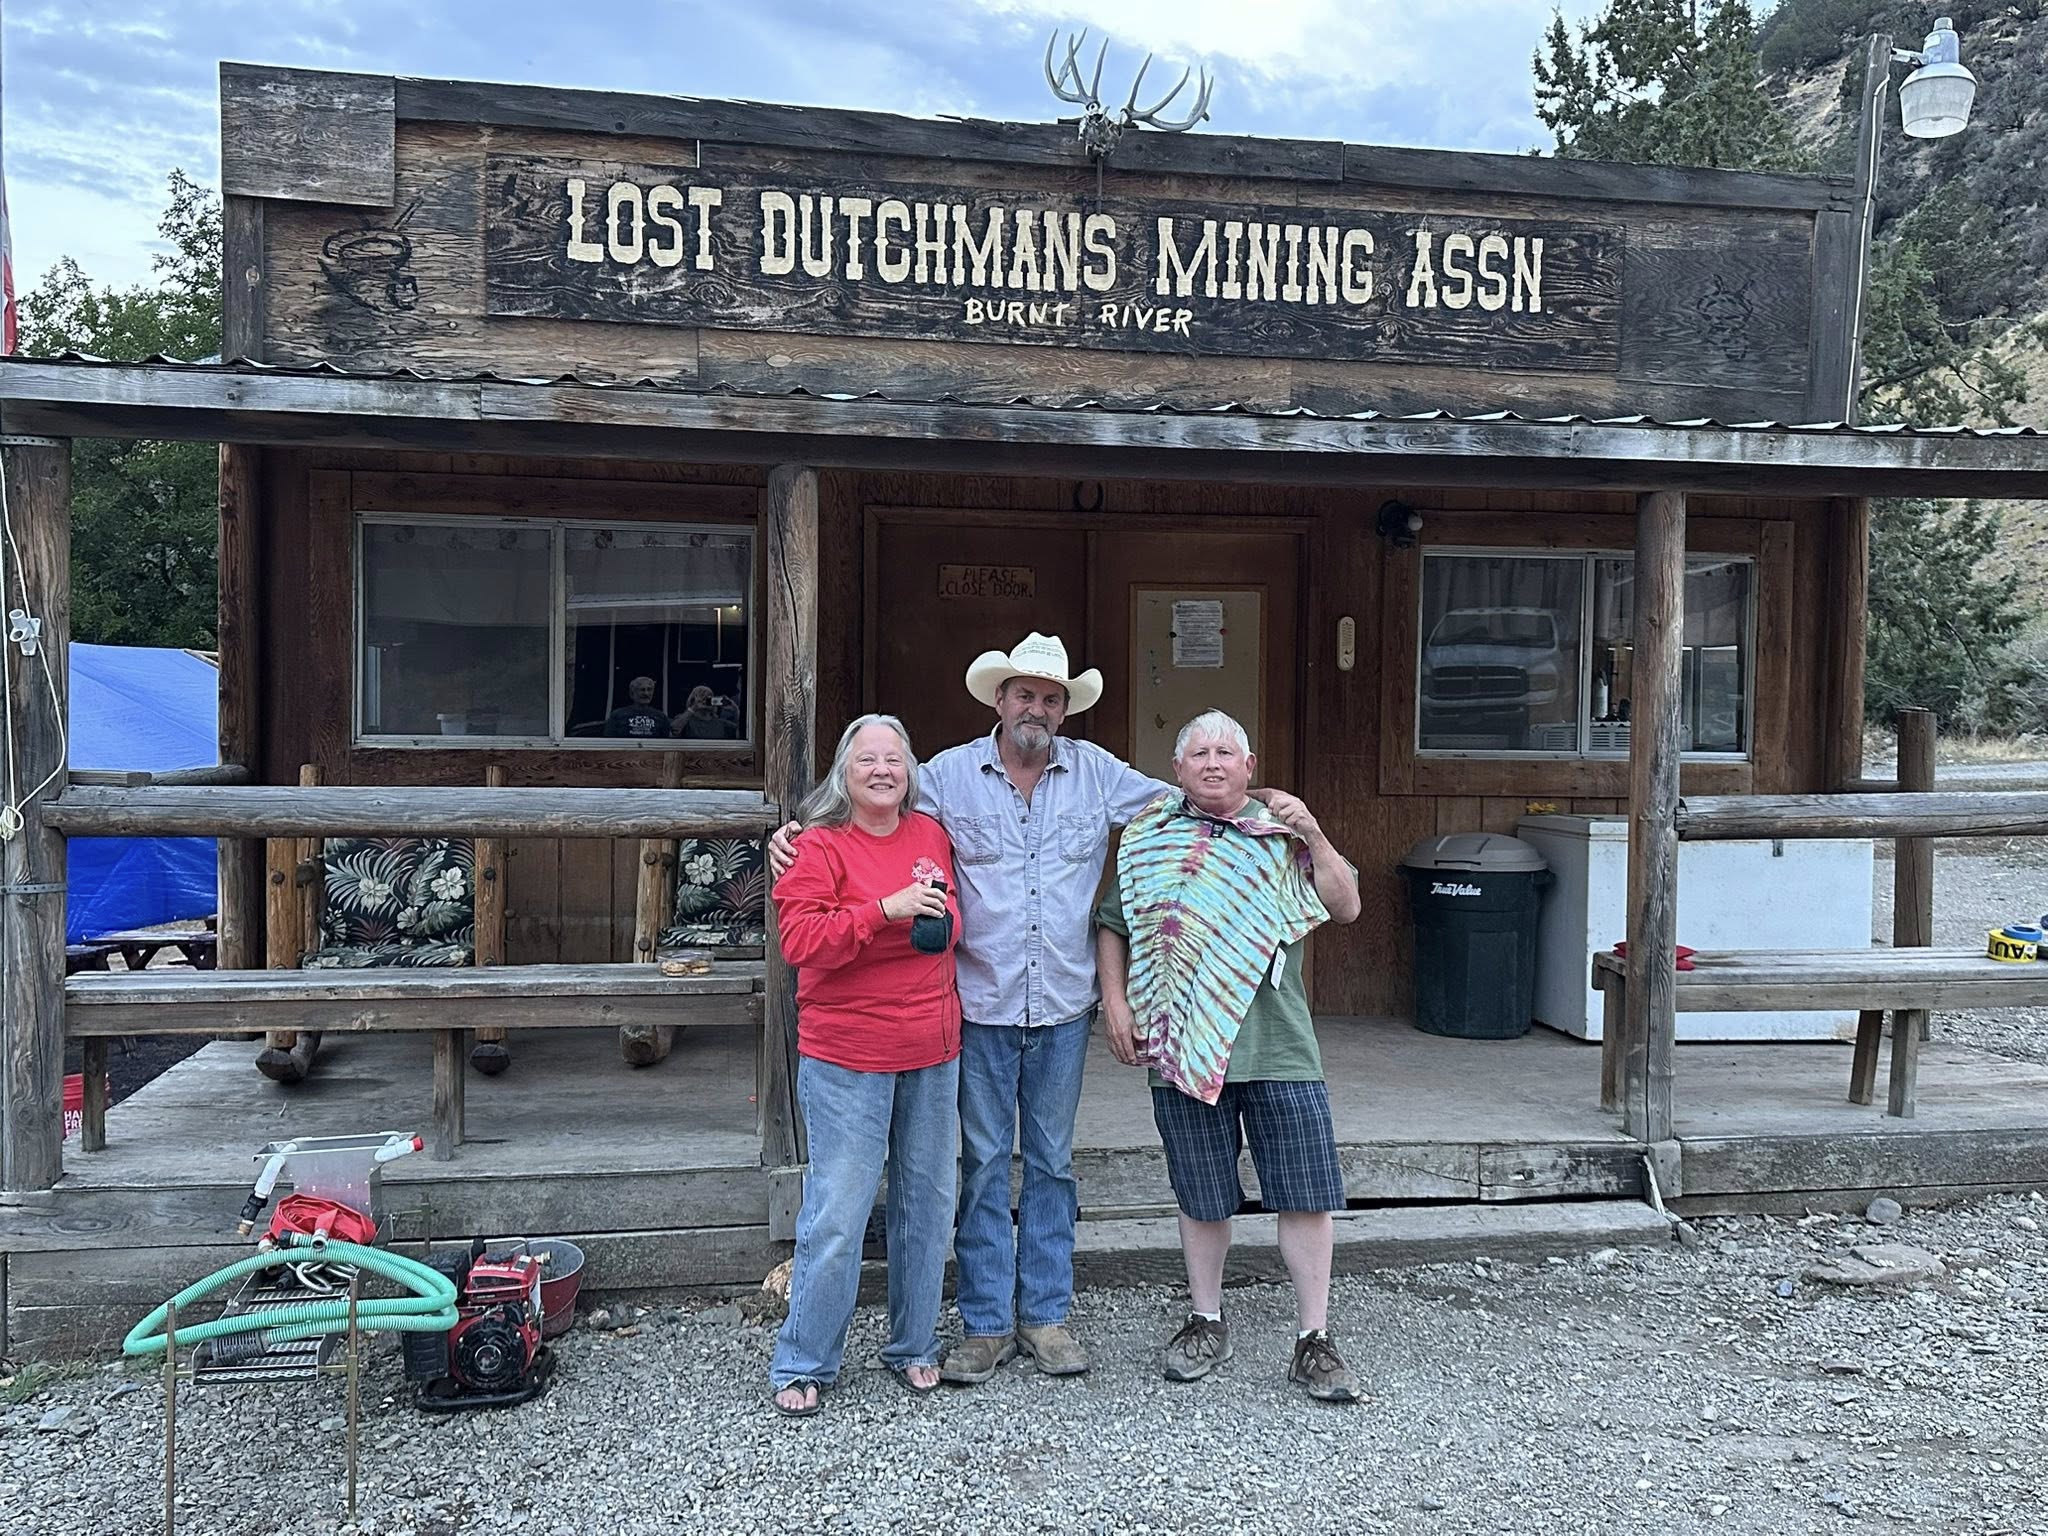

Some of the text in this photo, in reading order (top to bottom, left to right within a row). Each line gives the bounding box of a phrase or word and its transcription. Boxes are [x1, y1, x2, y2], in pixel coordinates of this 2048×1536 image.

[566, 178, 722, 271] LOST
[759, 191, 1117, 292] DUTCHMANS
[1156, 217, 1375, 305] MINING
[963, 297, 1193, 338] BURNT RIVER
[945, 580, 986, 597] CLOSE
[963, 567, 1018, 584] PLEASE
